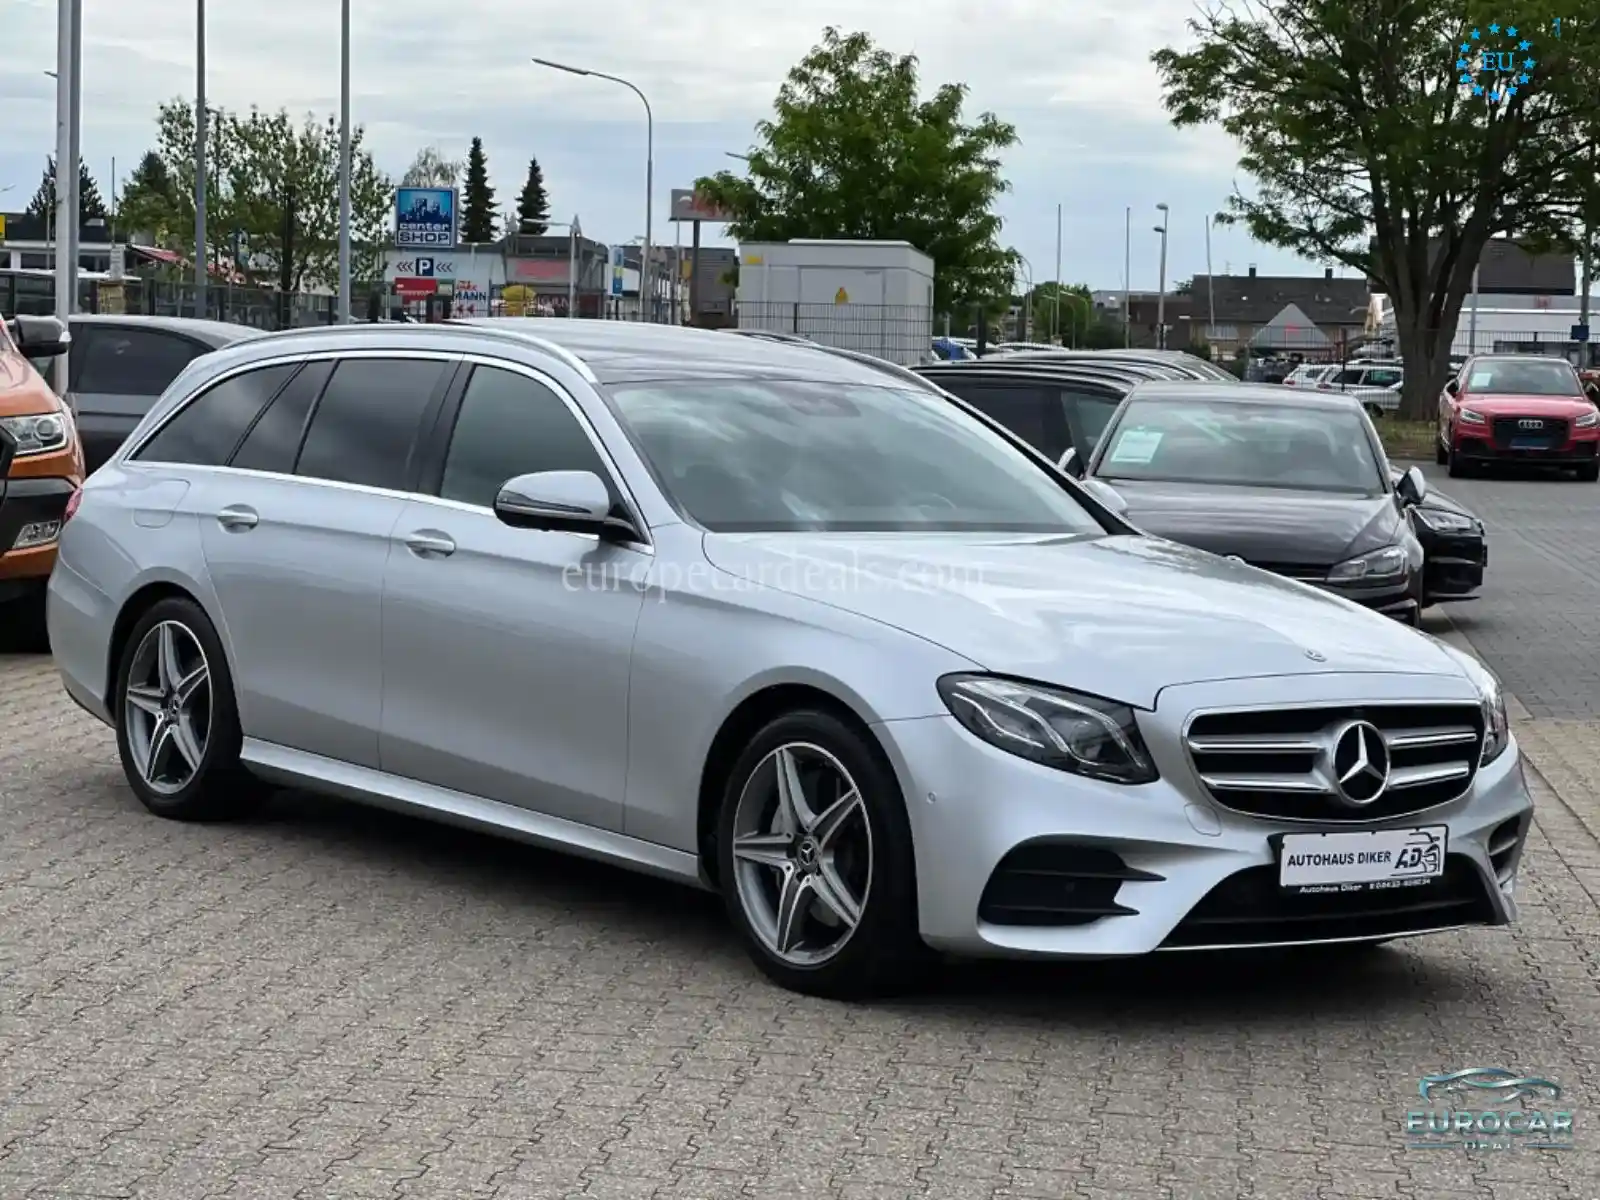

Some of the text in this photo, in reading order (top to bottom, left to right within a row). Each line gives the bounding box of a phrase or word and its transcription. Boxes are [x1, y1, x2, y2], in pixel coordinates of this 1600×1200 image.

[400, 222, 449, 231] center
[399, 232, 449, 243] SHOP
[419, 259, 431, 275] P
[1287, 851, 1391, 867] AUTOHAUS DIKER
